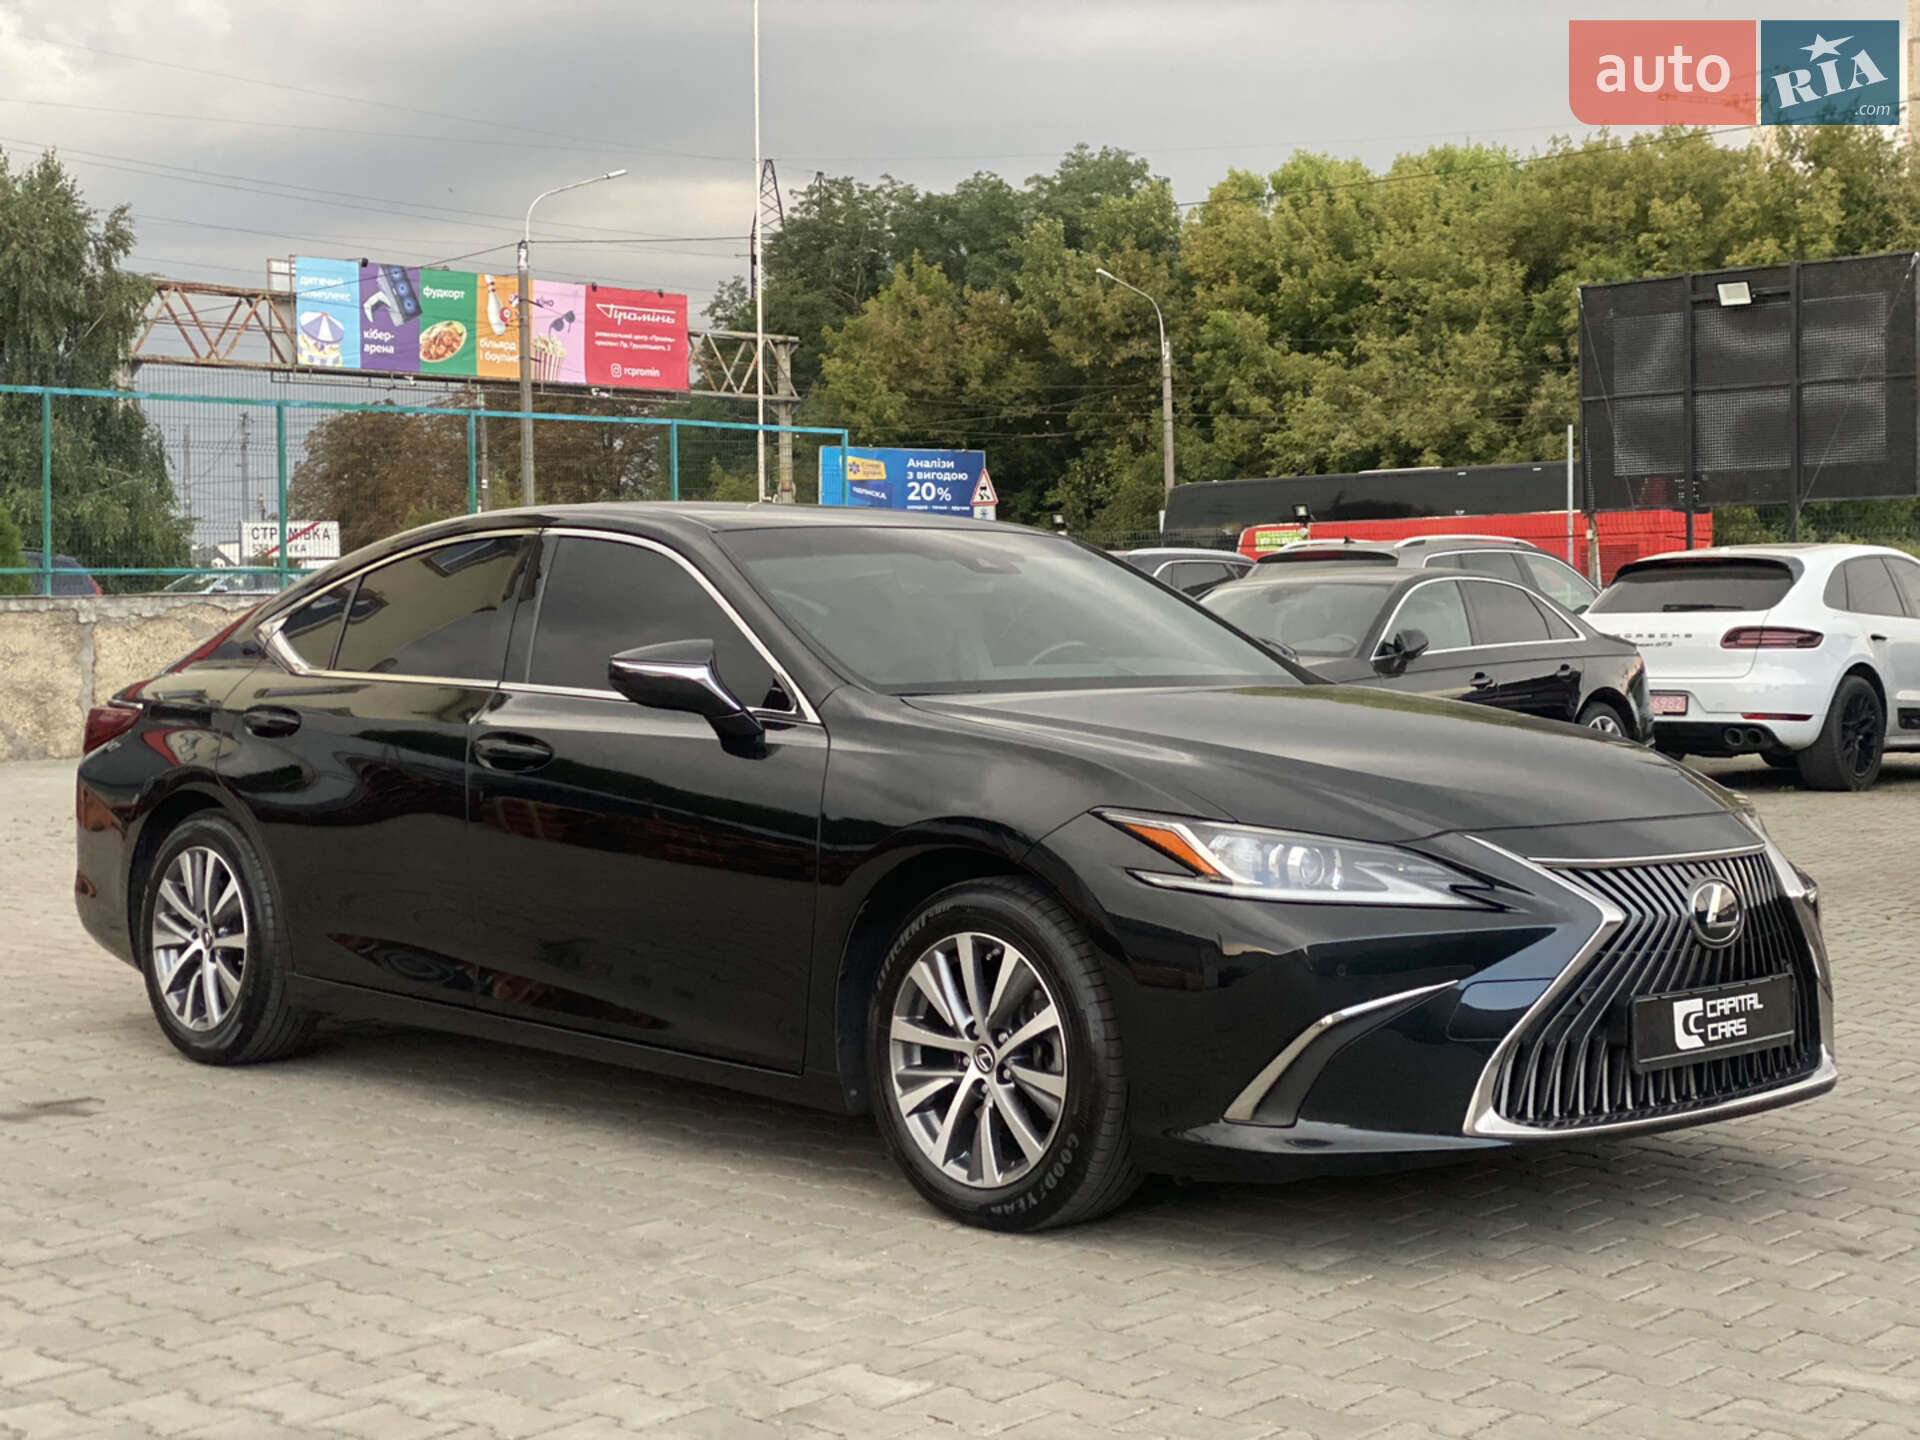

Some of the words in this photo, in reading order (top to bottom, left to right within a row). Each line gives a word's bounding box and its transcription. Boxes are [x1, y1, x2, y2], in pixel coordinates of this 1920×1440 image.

[363, 343, 395, 355] арена
[907, 458, 955, 469] Аналізи
[917, 471, 968, 482] вигодою
[907, 482, 952, 501] 20%
[251, 527, 331, 541] СТРМІВКА
[1706, 992, 1764, 1018] CAPITAL
[1707, 1018, 1748, 1042] CARS
